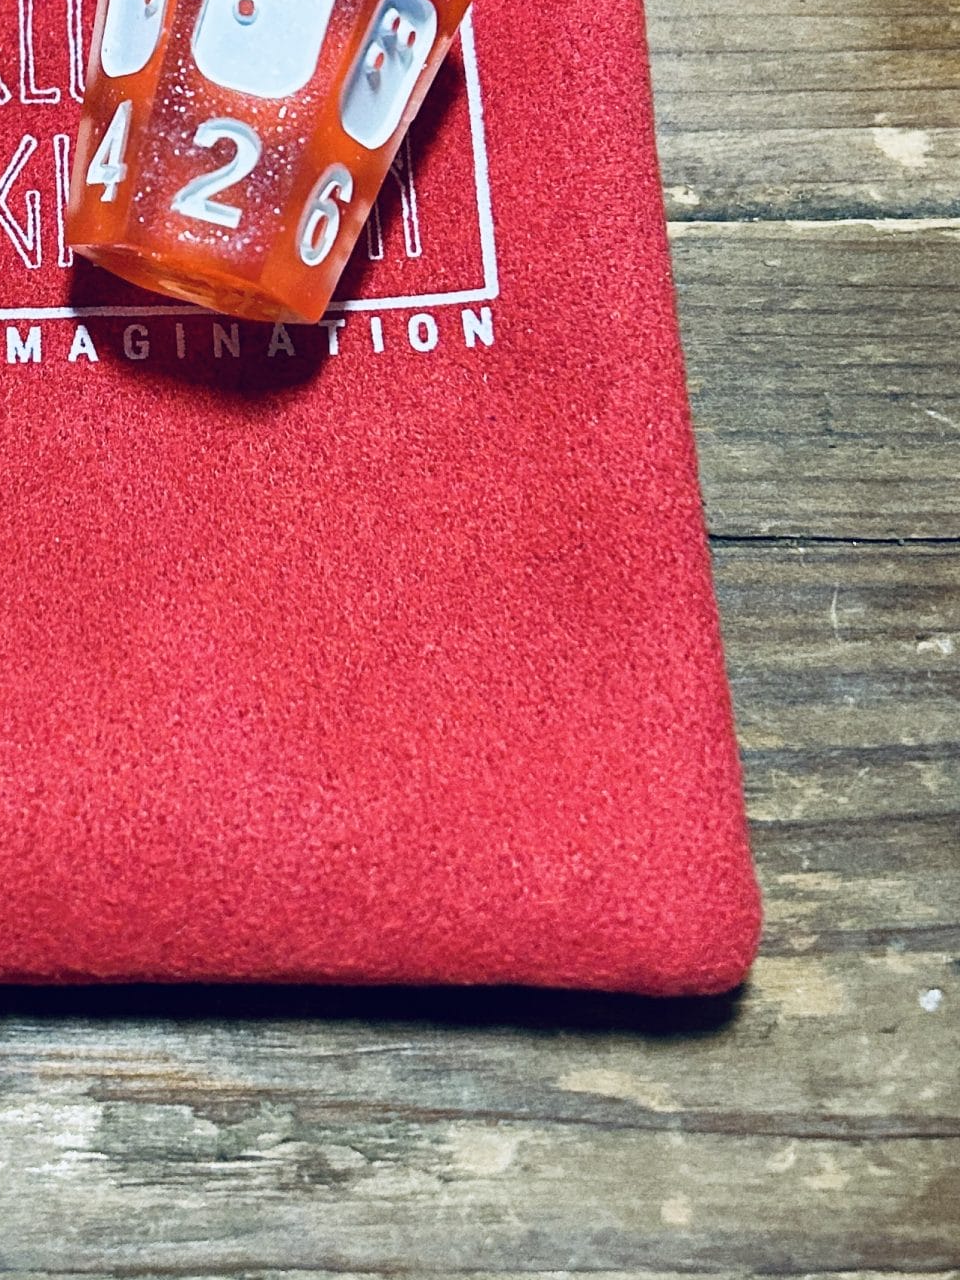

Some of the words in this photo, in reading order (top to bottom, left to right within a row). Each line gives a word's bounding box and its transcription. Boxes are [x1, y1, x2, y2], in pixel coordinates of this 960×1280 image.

[86, 99, 132, 202] 4
[171, 117, 262, 227] 2
[295, 162, 353, 266] 6
